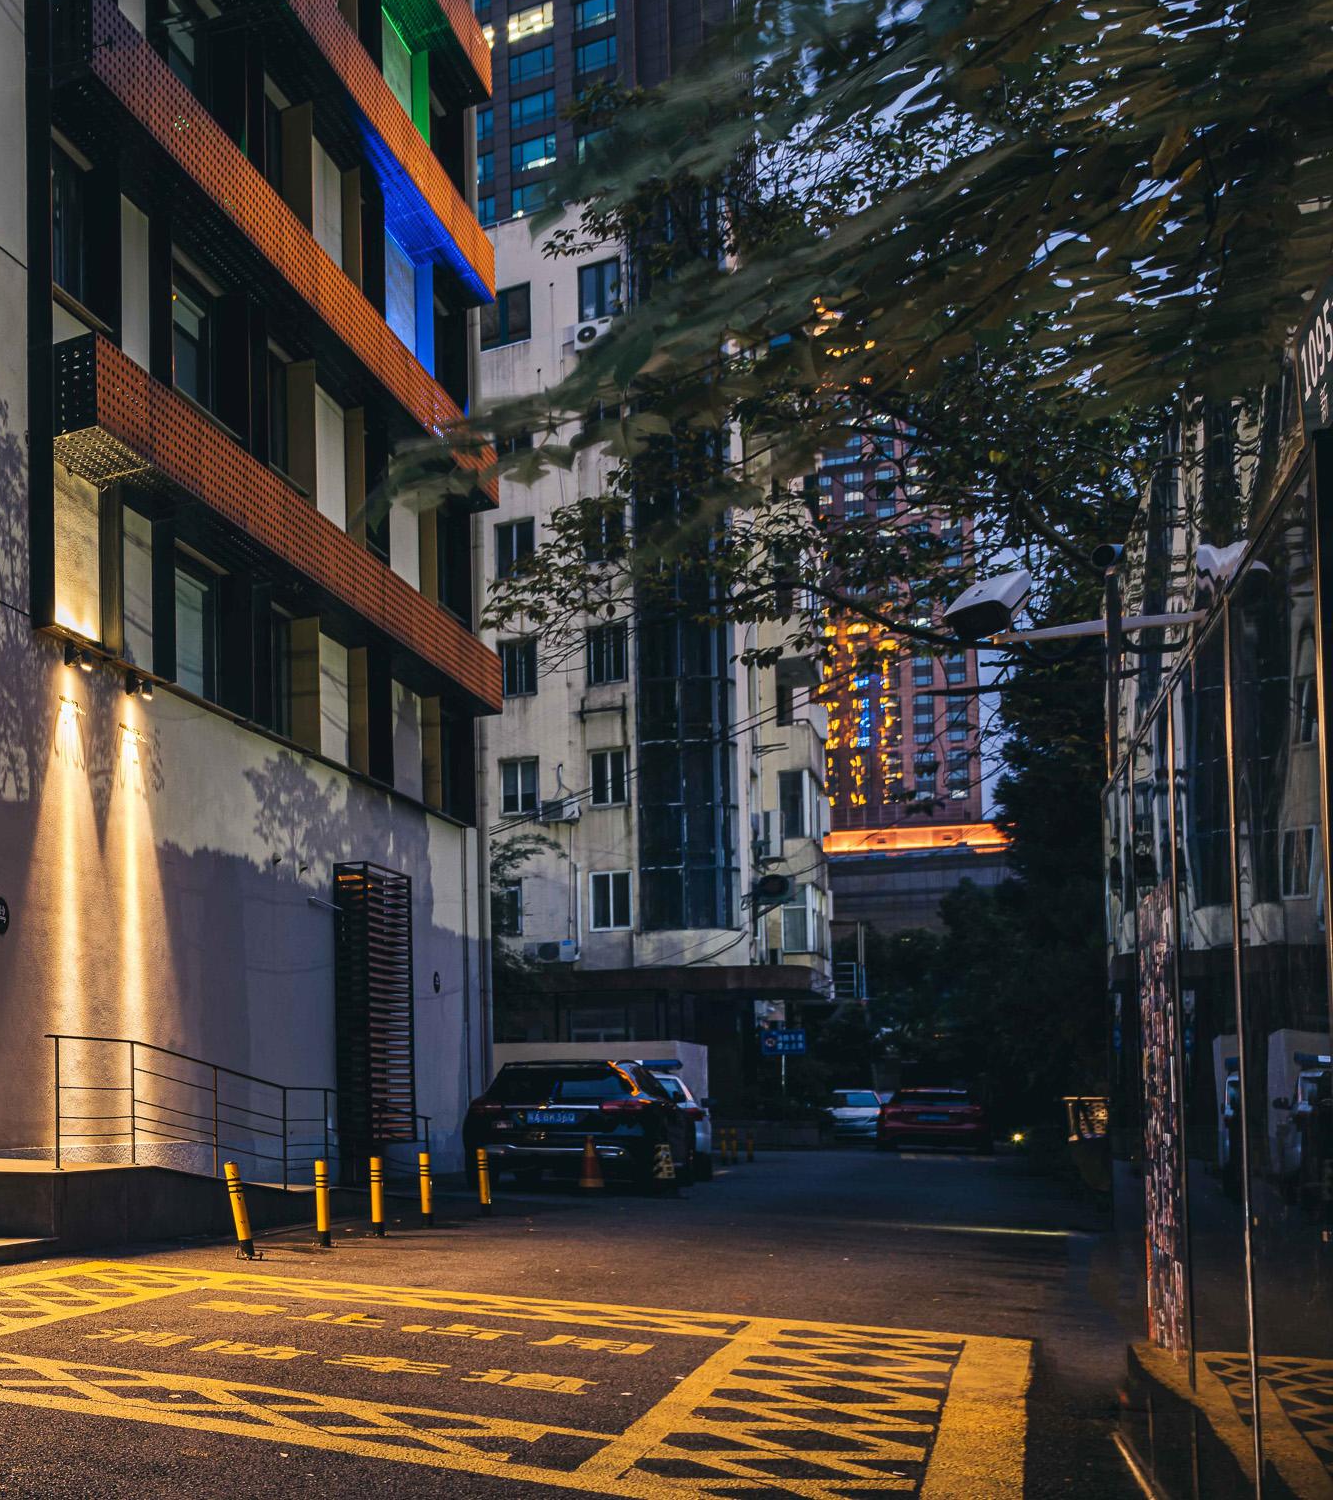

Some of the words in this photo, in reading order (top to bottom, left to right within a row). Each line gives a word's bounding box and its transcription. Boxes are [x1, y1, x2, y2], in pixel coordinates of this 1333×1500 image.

[188, 1300, 655, 1356] 禁止占用
[81, 1326, 600, 1396] 消防车道
